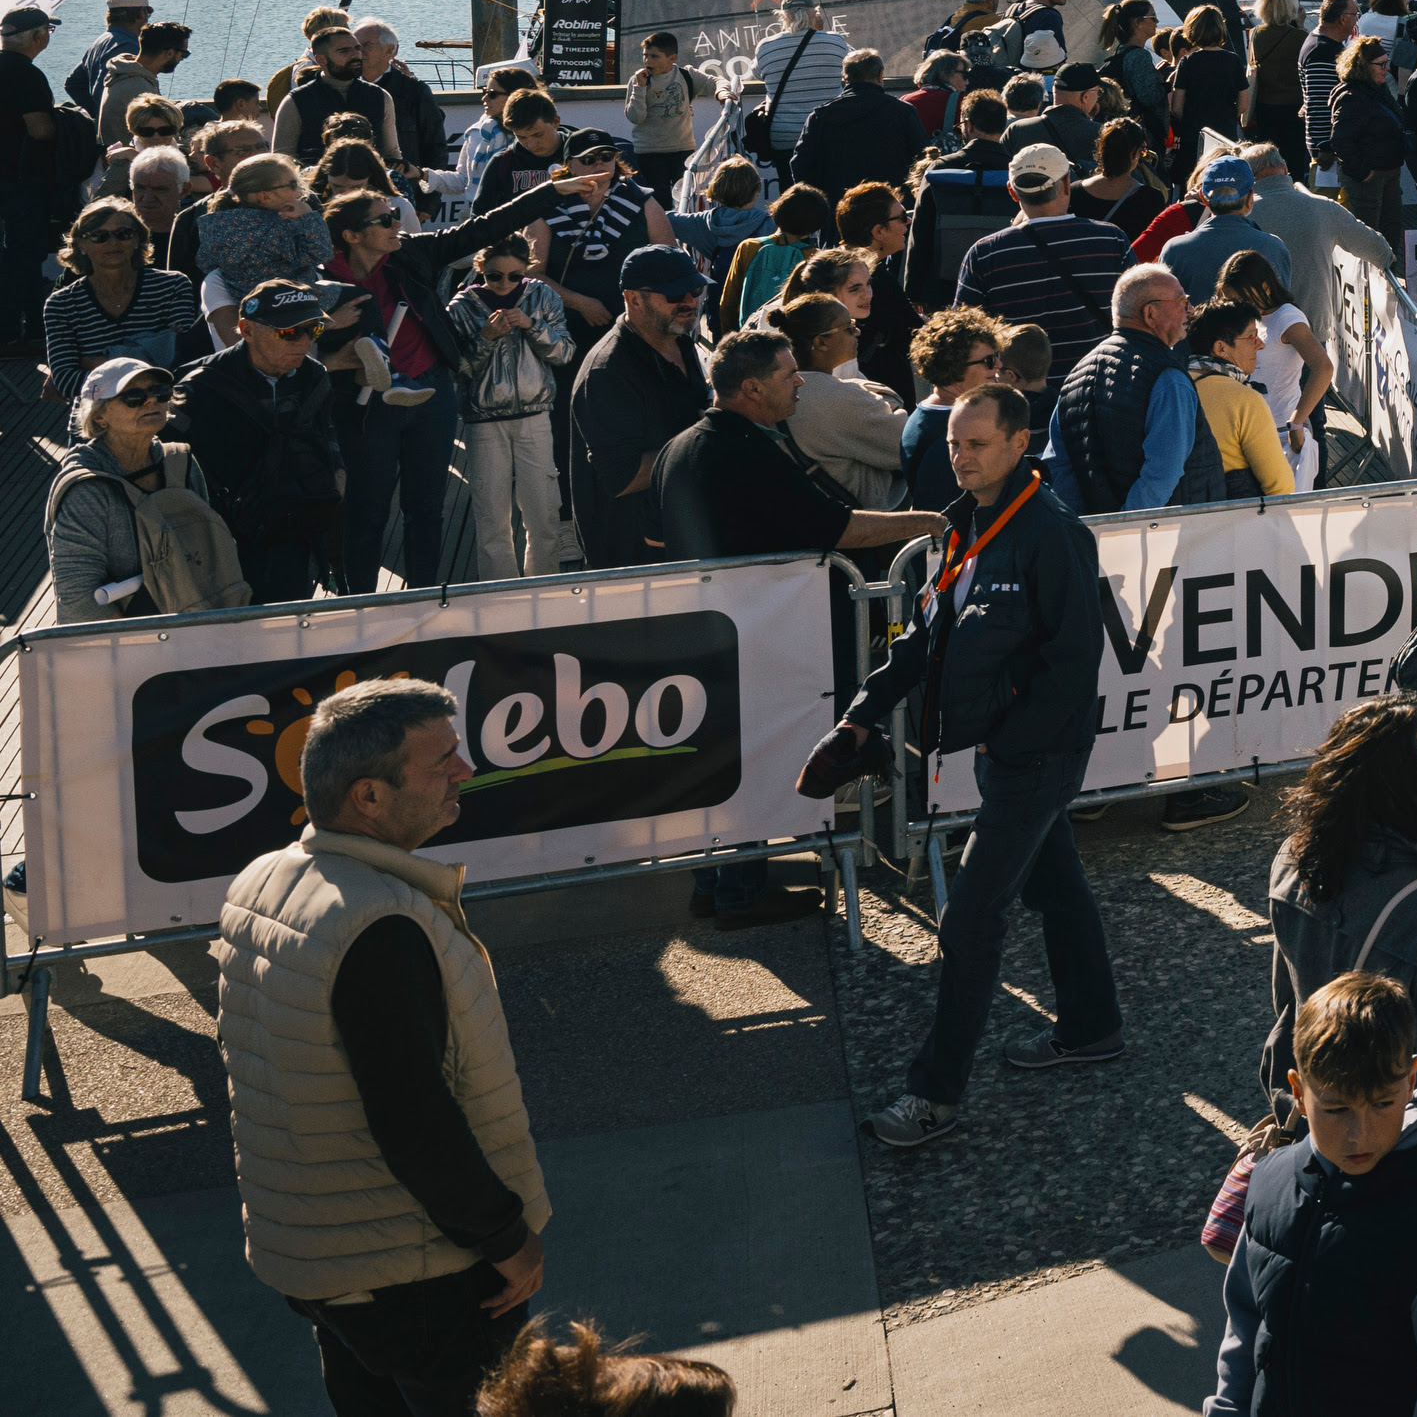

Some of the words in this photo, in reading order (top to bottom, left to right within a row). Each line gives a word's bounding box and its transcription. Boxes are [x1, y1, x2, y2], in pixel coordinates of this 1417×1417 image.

[552, 19, 602, 30] Robline
[549, 58, 594, 67] Promocash
[557, 70, 593, 81] SLAM
[512, 168, 550, 194] YOKO
[1169, 656, 1400, 726] DÉPARTE
[176, 651, 708, 836] Sebo
